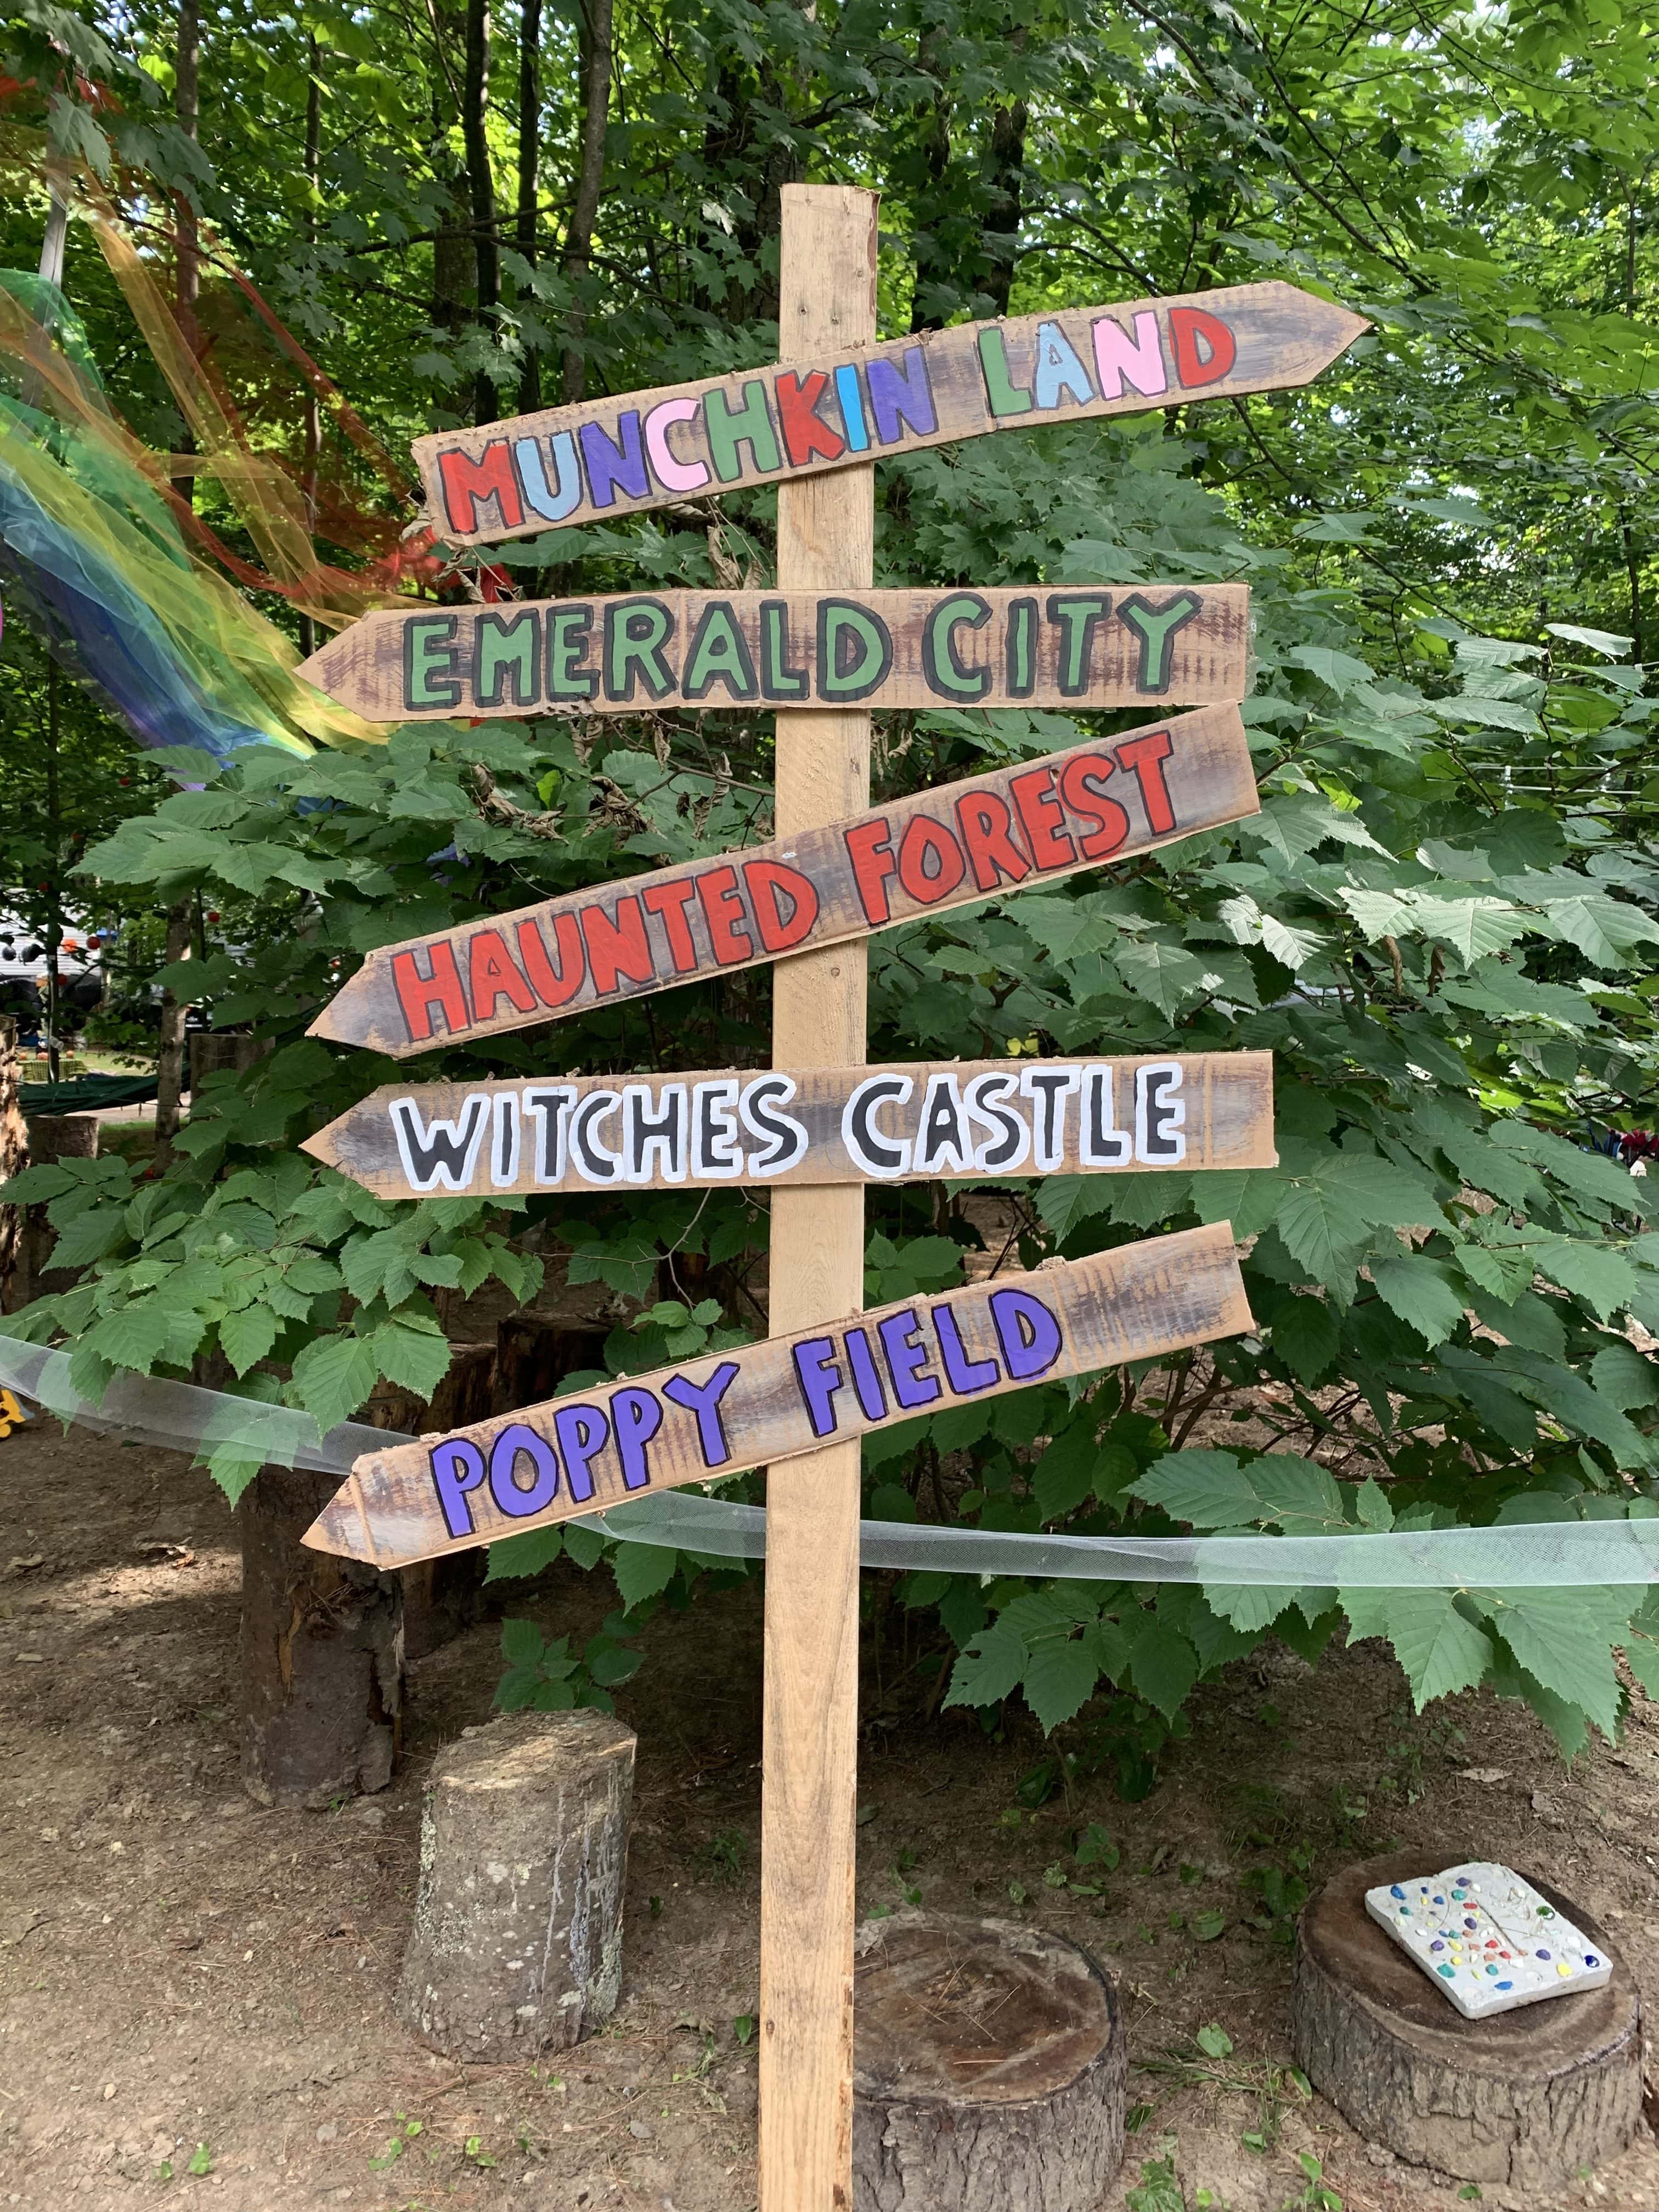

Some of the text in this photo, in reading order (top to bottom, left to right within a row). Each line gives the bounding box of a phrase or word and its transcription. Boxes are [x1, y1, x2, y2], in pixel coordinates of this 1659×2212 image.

[437, 306, 1237, 534] MUNCHKIN LAND
[403, 589, 1204, 711] EMERALD CITY
[391, 730, 1173, 1043] HAUNTED FOREST
[388, 1062, 1186, 1191] WITCHES CASTLE
[430, 1288, 1063, 1539] POPPY FIELD
